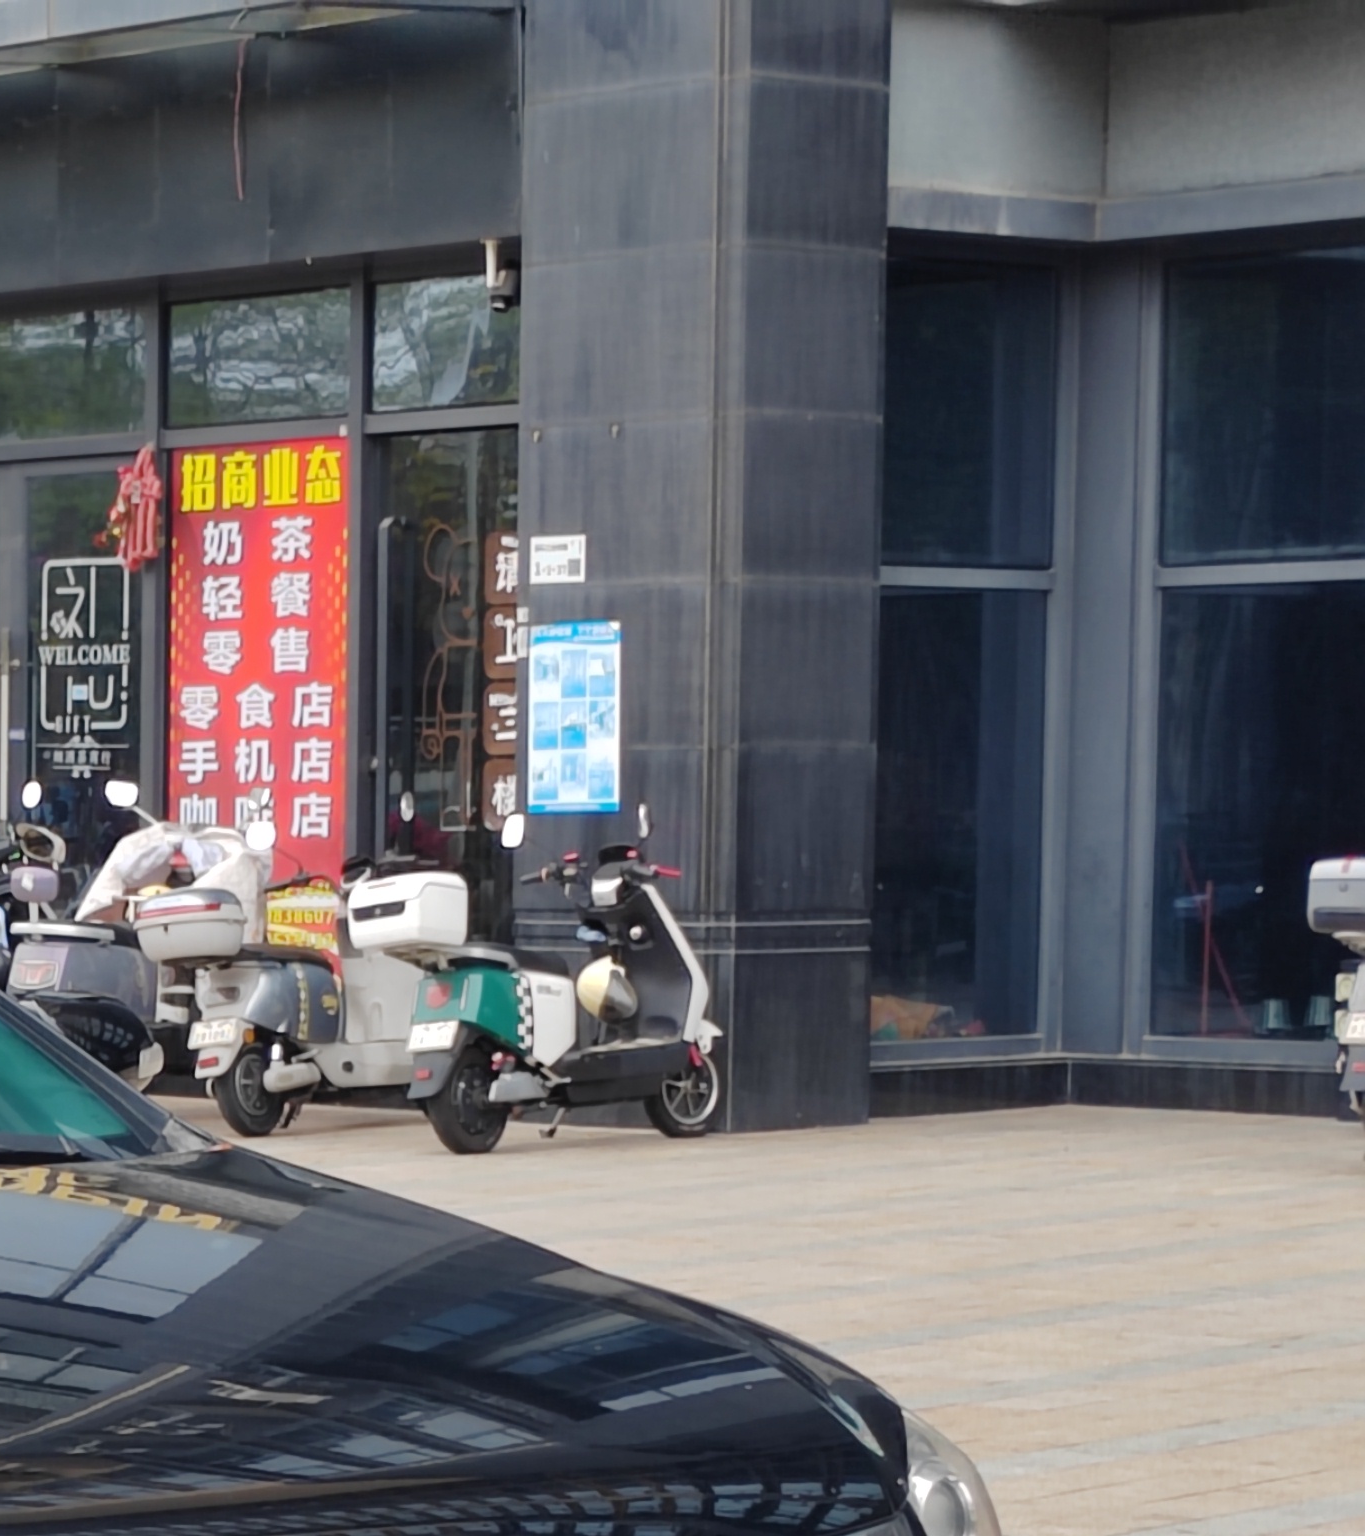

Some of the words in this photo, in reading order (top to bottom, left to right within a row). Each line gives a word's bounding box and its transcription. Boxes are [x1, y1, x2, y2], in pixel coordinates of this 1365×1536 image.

[180, 444, 343, 514] 招商业态
[202, 515, 313, 566] 奶茶
[201, 571, 312, 623] 轻餐
[38, 643, 131, 666] WELCOME
[202, 626, 311, 677] 零售
[179, 682, 333, 731] 零食店
[179, 737, 333, 785] 手机店
